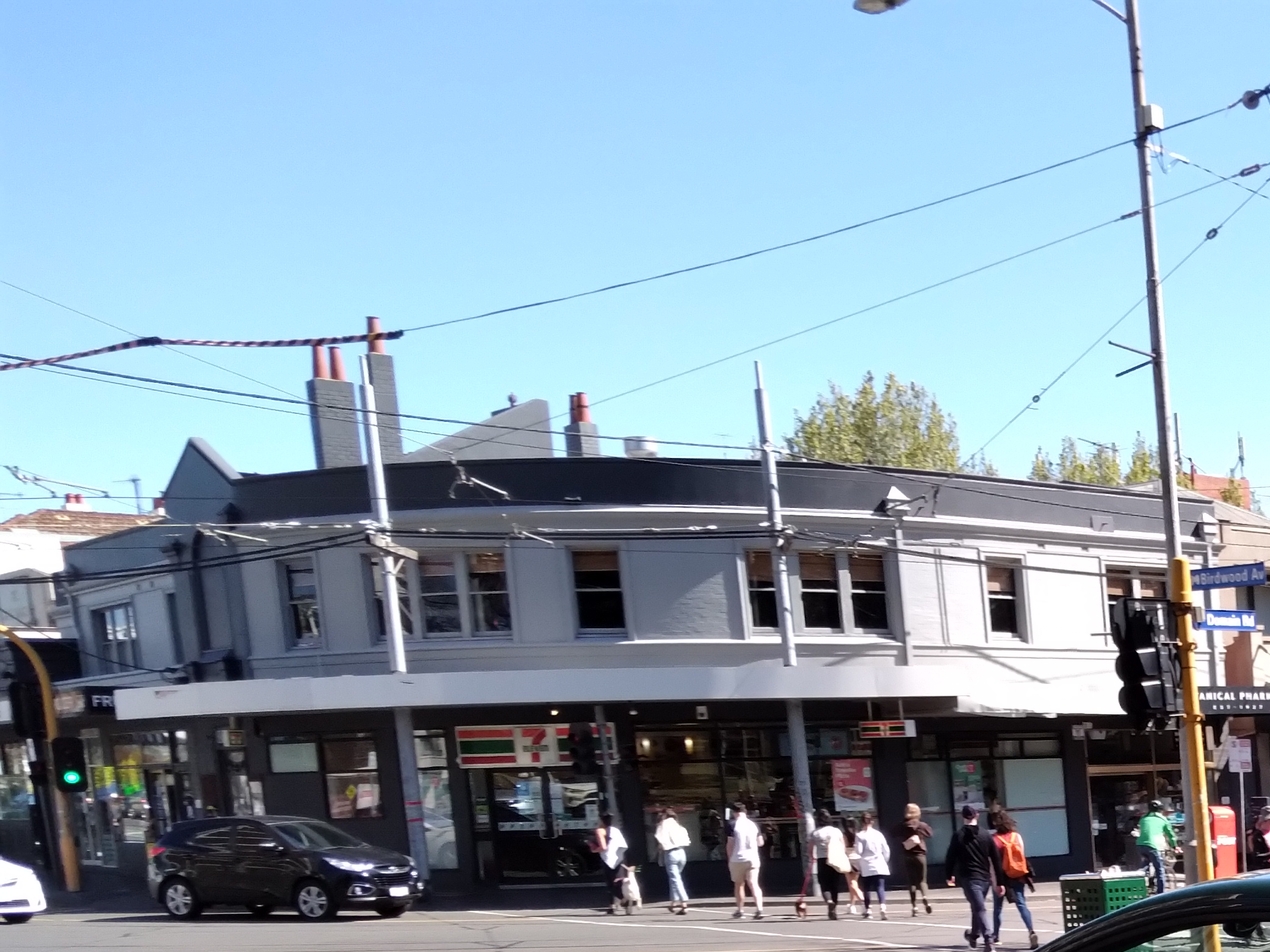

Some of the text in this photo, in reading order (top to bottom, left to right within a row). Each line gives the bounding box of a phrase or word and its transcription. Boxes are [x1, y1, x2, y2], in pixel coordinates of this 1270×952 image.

[1200, 569, 1248, 586] Birdwood
[1251, 568, 1265, 581] Av
[1206, 613, 1241, 627] Domain
[91, 695, 114, 707] FR
[1197, 691, 1236, 701] ANICAL
[521, 728, 546, 762] 7
